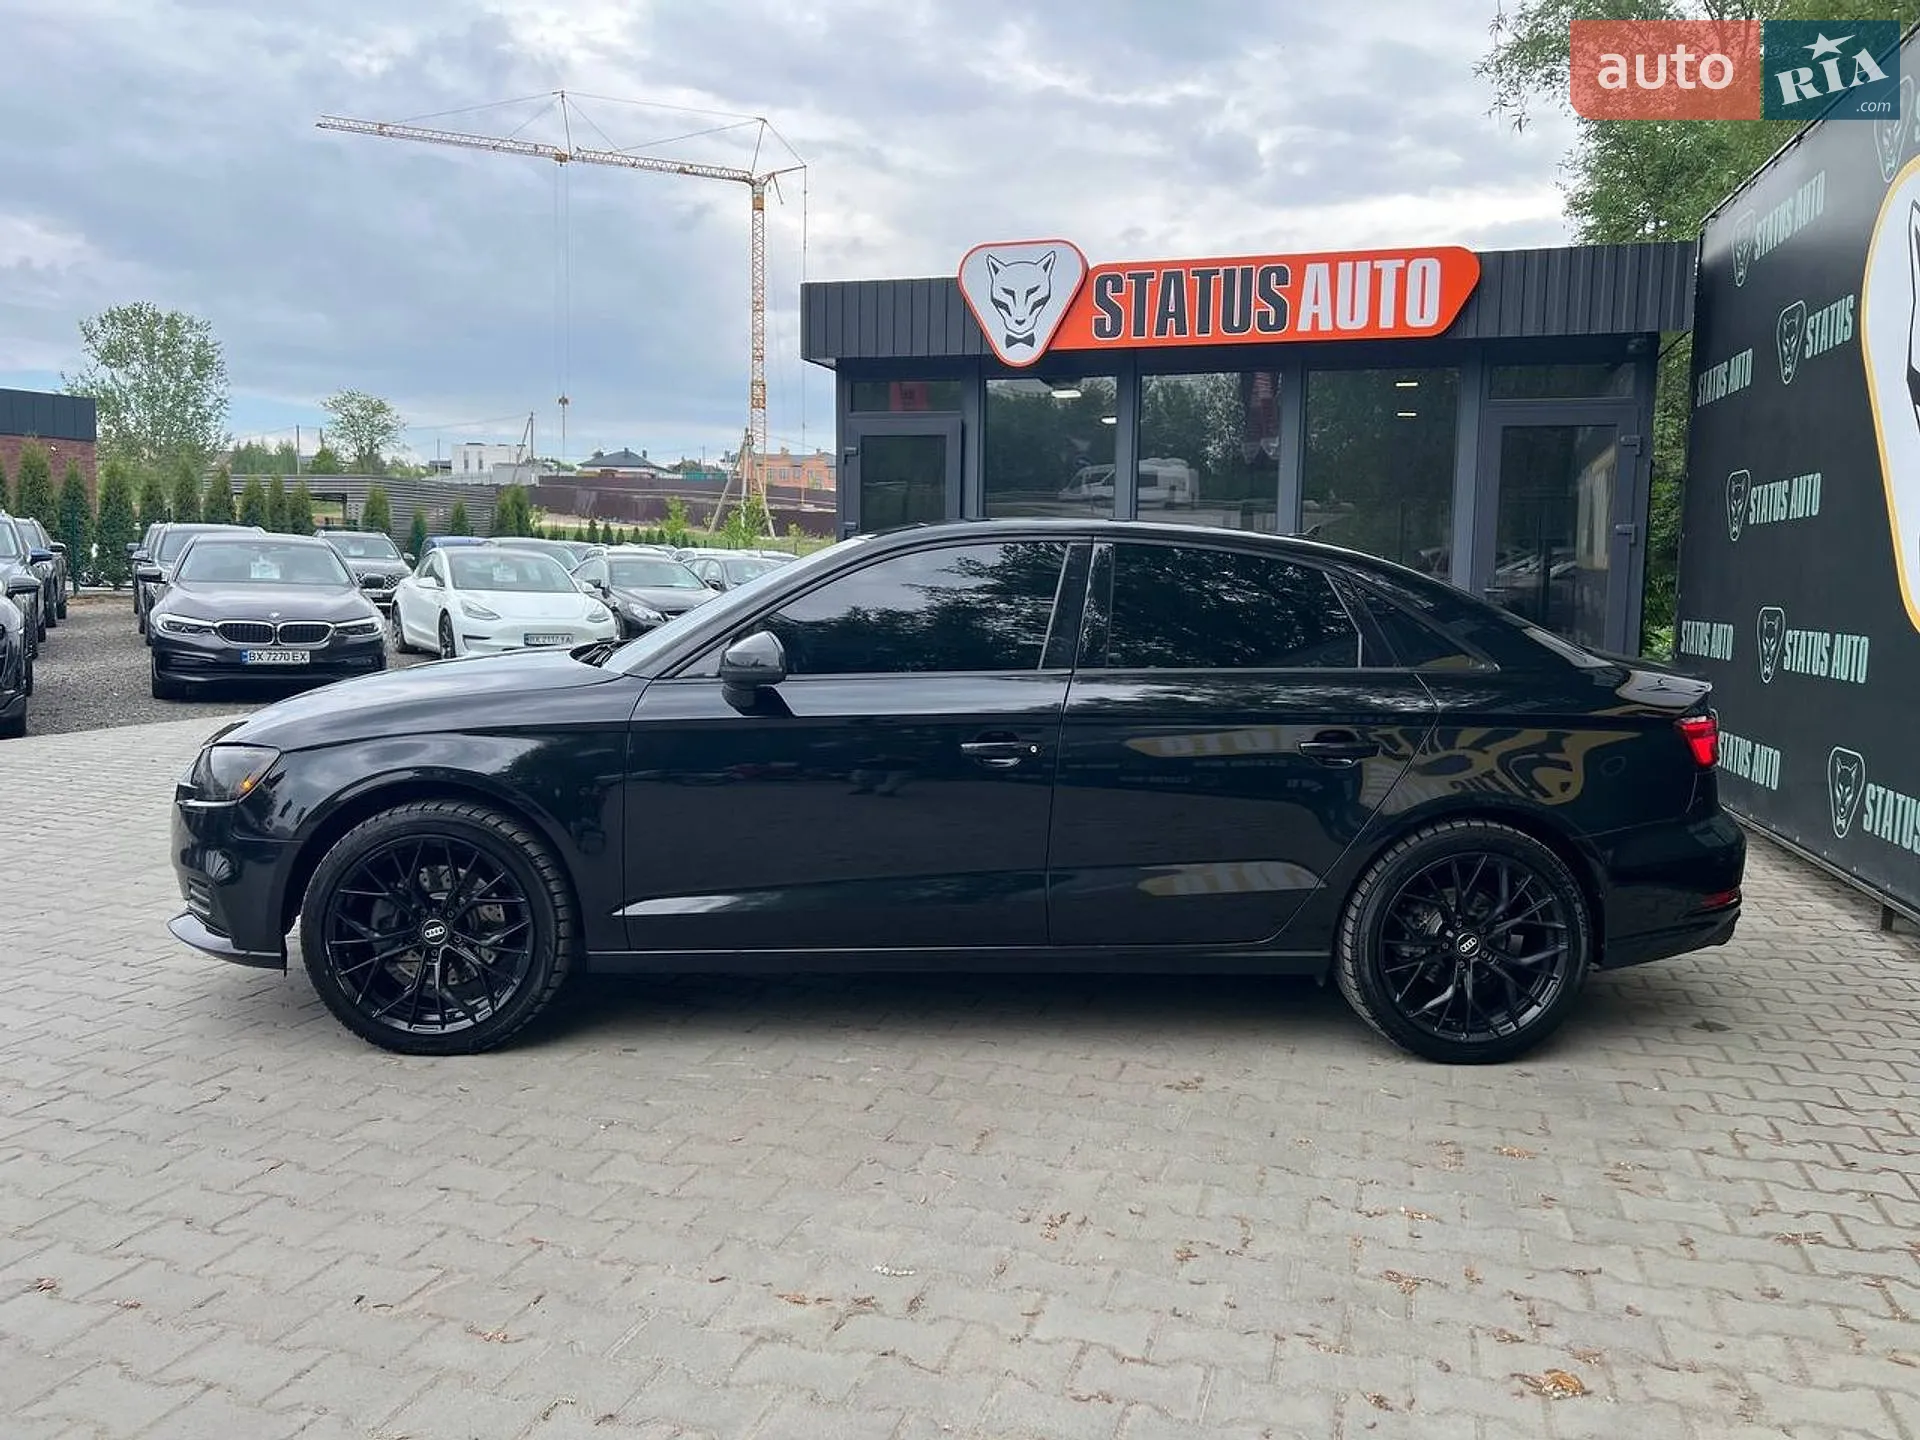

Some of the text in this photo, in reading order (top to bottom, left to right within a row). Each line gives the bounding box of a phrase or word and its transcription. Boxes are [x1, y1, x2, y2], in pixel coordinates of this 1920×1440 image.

[1753, 170, 1825, 261] STATUS AUTO
[1092, 257, 1442, 341] STATUS AUTO
[1805, 294, 1854, 359] STATUS
[1696, 348, 1753, 407] STATUS AUTO
[1749, 472, 1821, 525] STATUS AUTO
[1680, 620, 1734, 661] STATUS AUTO
[1783, 629, 1869, 683] STATUS AUTO
[1717, 730, 1781, 791] STATUS AUTO
[1863, 783, 1920, 855] STATUS
